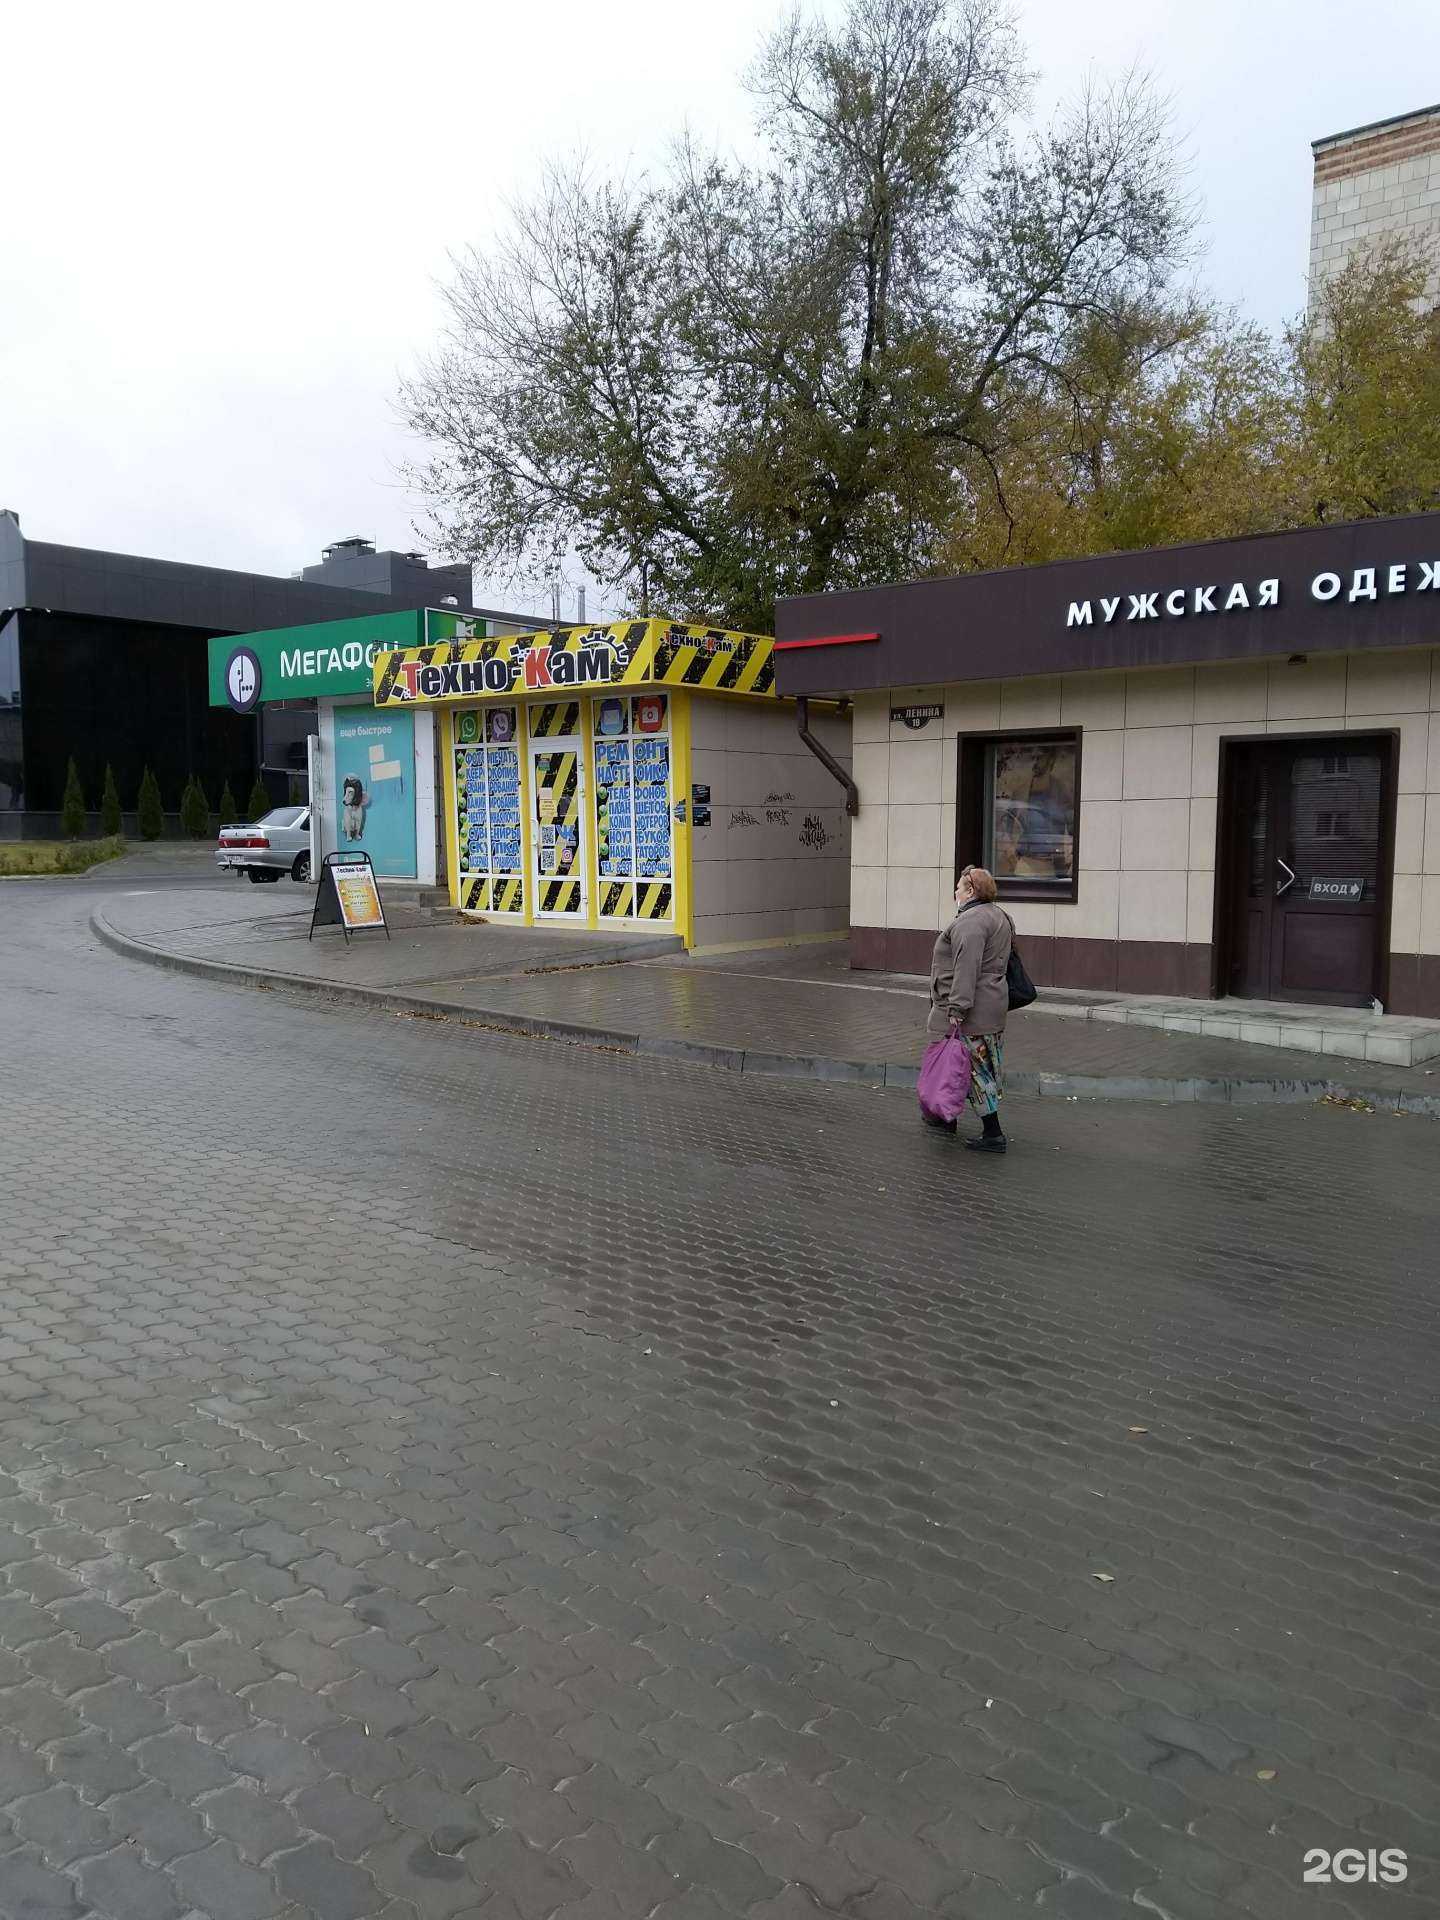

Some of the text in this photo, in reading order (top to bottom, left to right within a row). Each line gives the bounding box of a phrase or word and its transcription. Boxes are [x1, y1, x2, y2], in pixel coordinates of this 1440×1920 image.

[1066, 578, 1279, 627] МУЖСКАЯ
[906, 707, 940, 718] ЛЕНИНА
[596, 742, 667, 761] РЕМОНТ
[608, 785, 667, 800] ТЕЛЕФОНОВ
[608, 800, 667, 815] ПЛАНШЕТОВ
[469, 841, 520, 854] СКУПКА
[609, 844, 671, 859] НАВИГАТОРОВ
[1313, 883, 1348, 895] ВХОД
